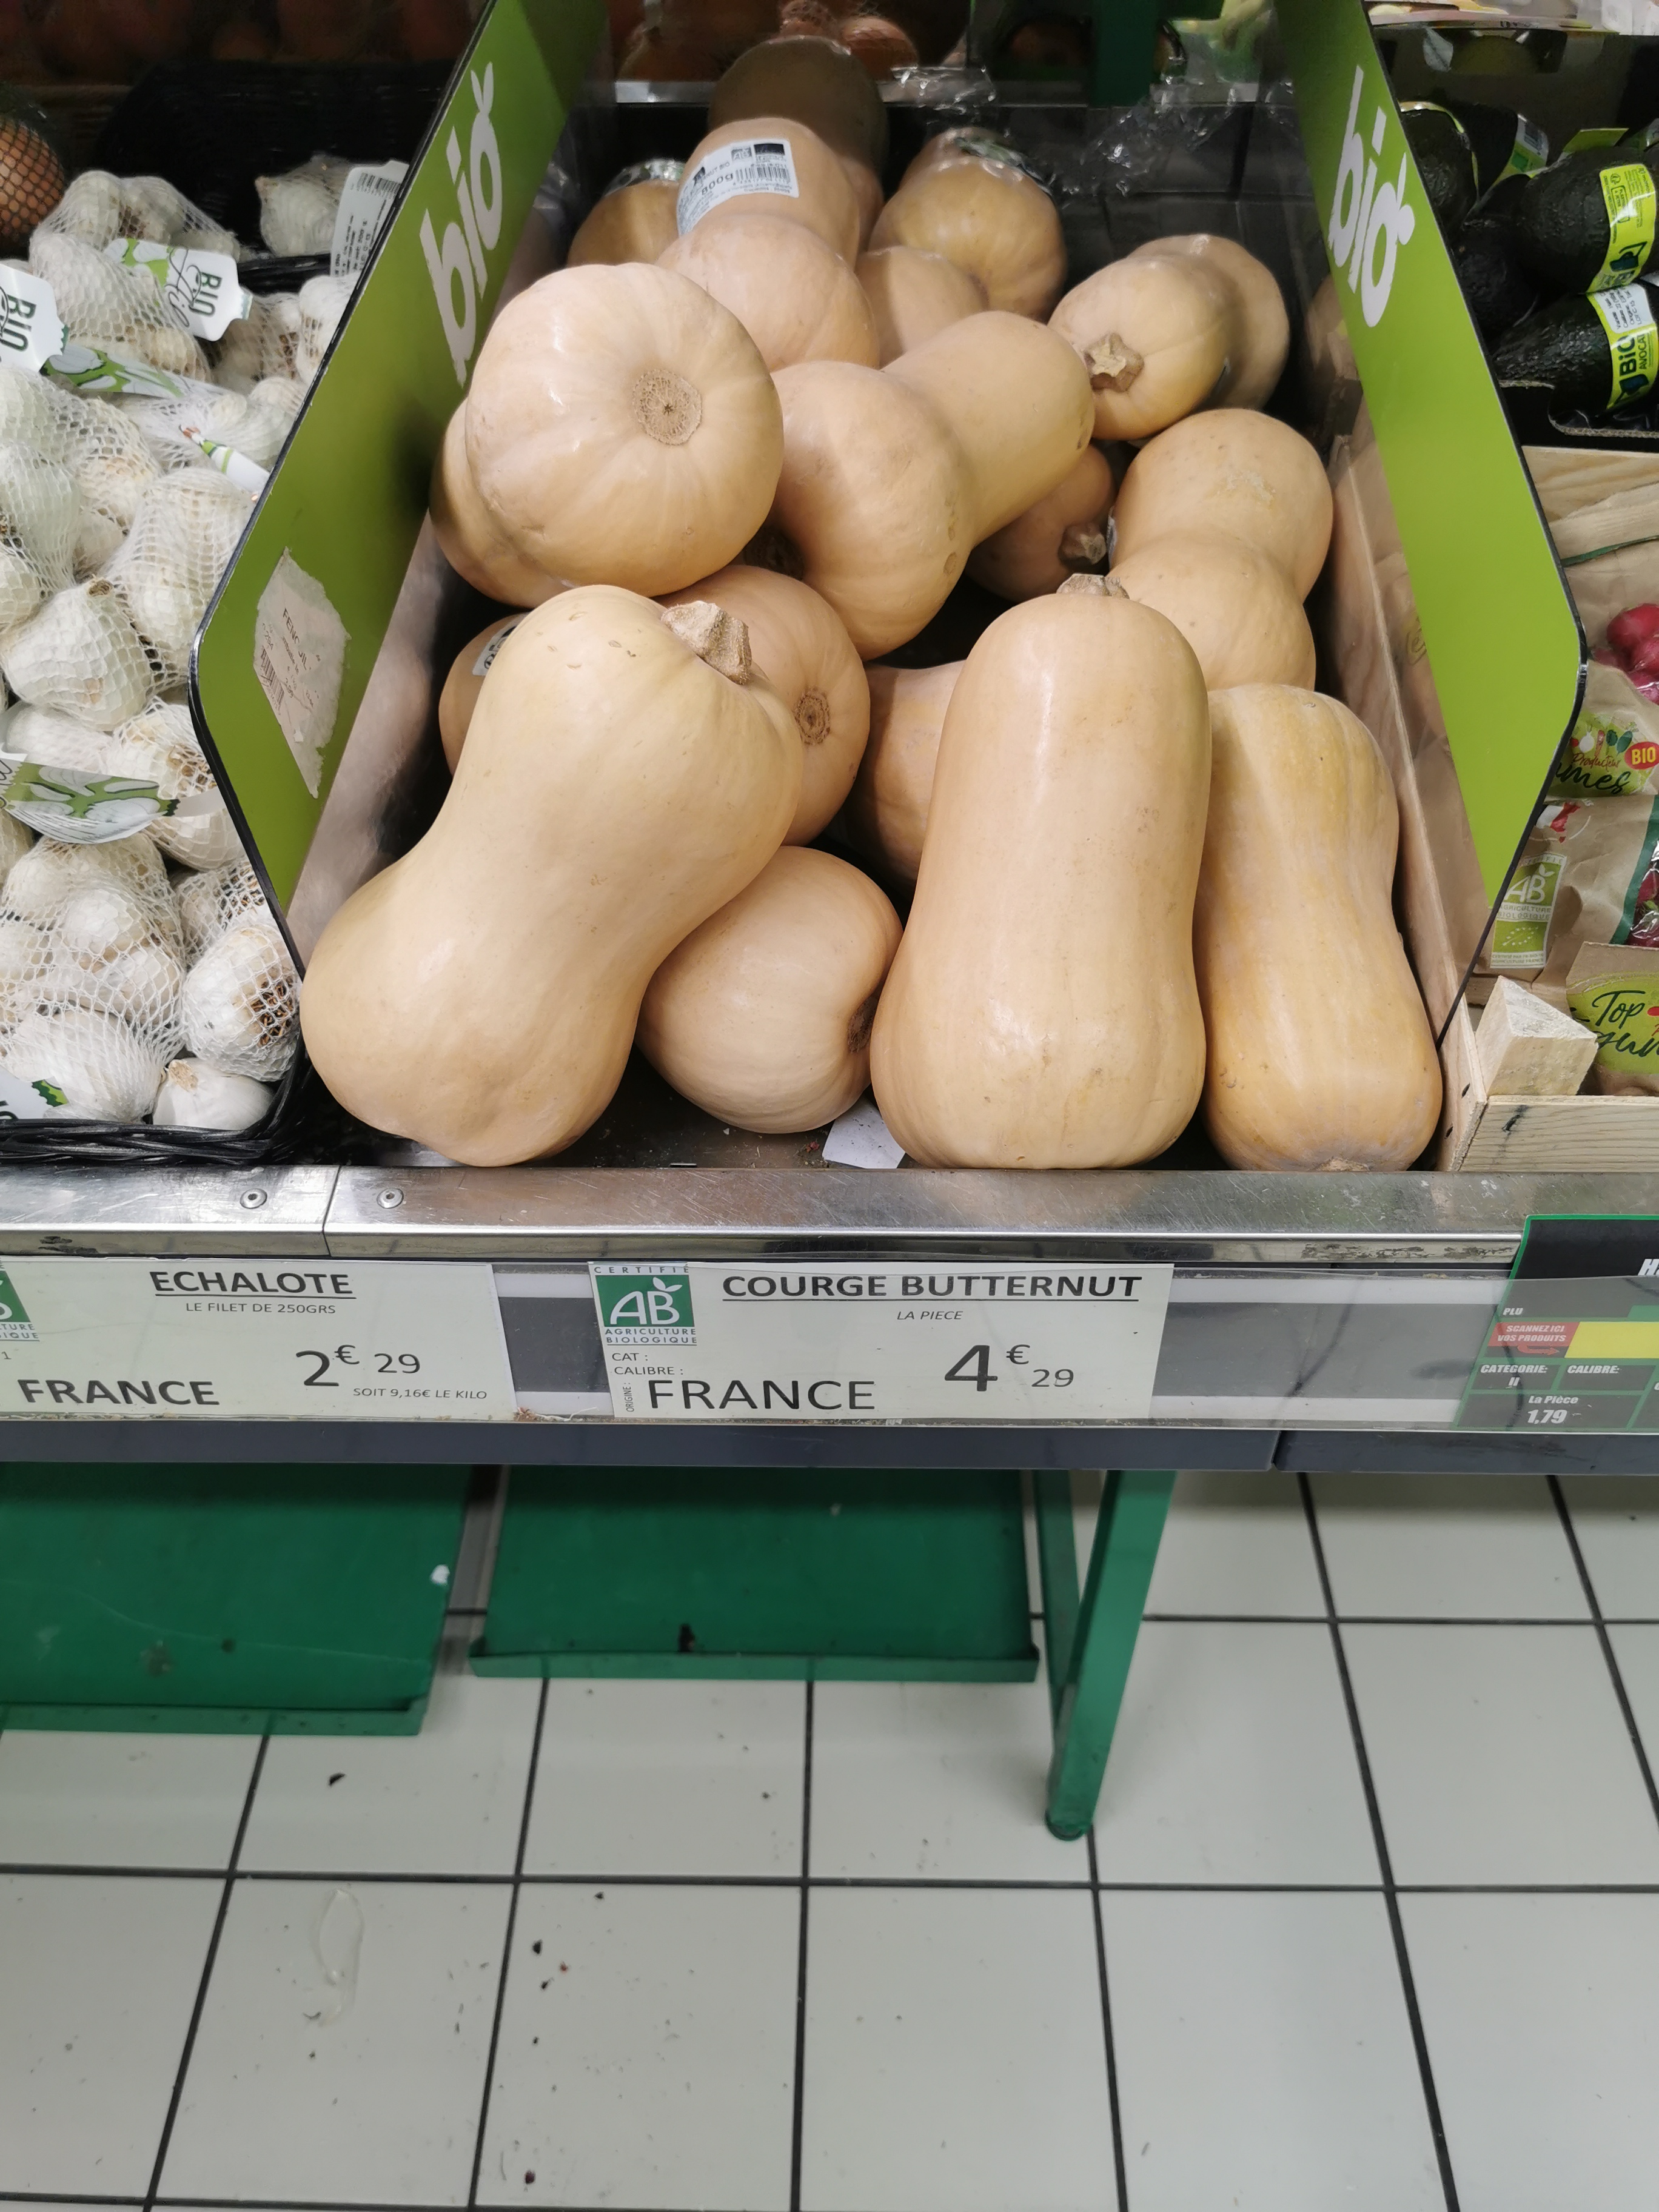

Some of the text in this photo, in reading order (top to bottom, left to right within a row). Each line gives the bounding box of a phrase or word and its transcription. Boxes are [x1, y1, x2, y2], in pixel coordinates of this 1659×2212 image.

[701, 172, 734, 196] 800g
[188, 271, 223, 318] BIO
[1632, 747, 1656, 765] BIO
[1504, 875, 1546, 903] AB
[1592, 990, 1646, 1029] Top
[594, 1264, 689, 1273] CERTIFIÉ
[149, 1271, 353, 1295] ECHALOTE
[723, 1275, 1142, 1297] COURGE BUTTERNUT
[186, 1302, 336, 1314] LE FILET DE 250GRS
[610, 1290, 680, 1324] AB
[897, 1310, 964, 1320] LA PIECE
[1480, 1364, 1548, 1373] CATEGORIE:
[1567, 1365, 1620, 1373] CALIBRE:
[1508, 1377, 1521, 1386] II
[17, 1379, 221, 1406] FRANCE
[353, 1387, 488, 1399] SOIT 9,16€ LE KILO
[648, 1379, 876, 1410] FRANCE
[1529, 1395, 1579, 1404] La Pièce
[1527, 1409, 1568, 1424] 1,79
